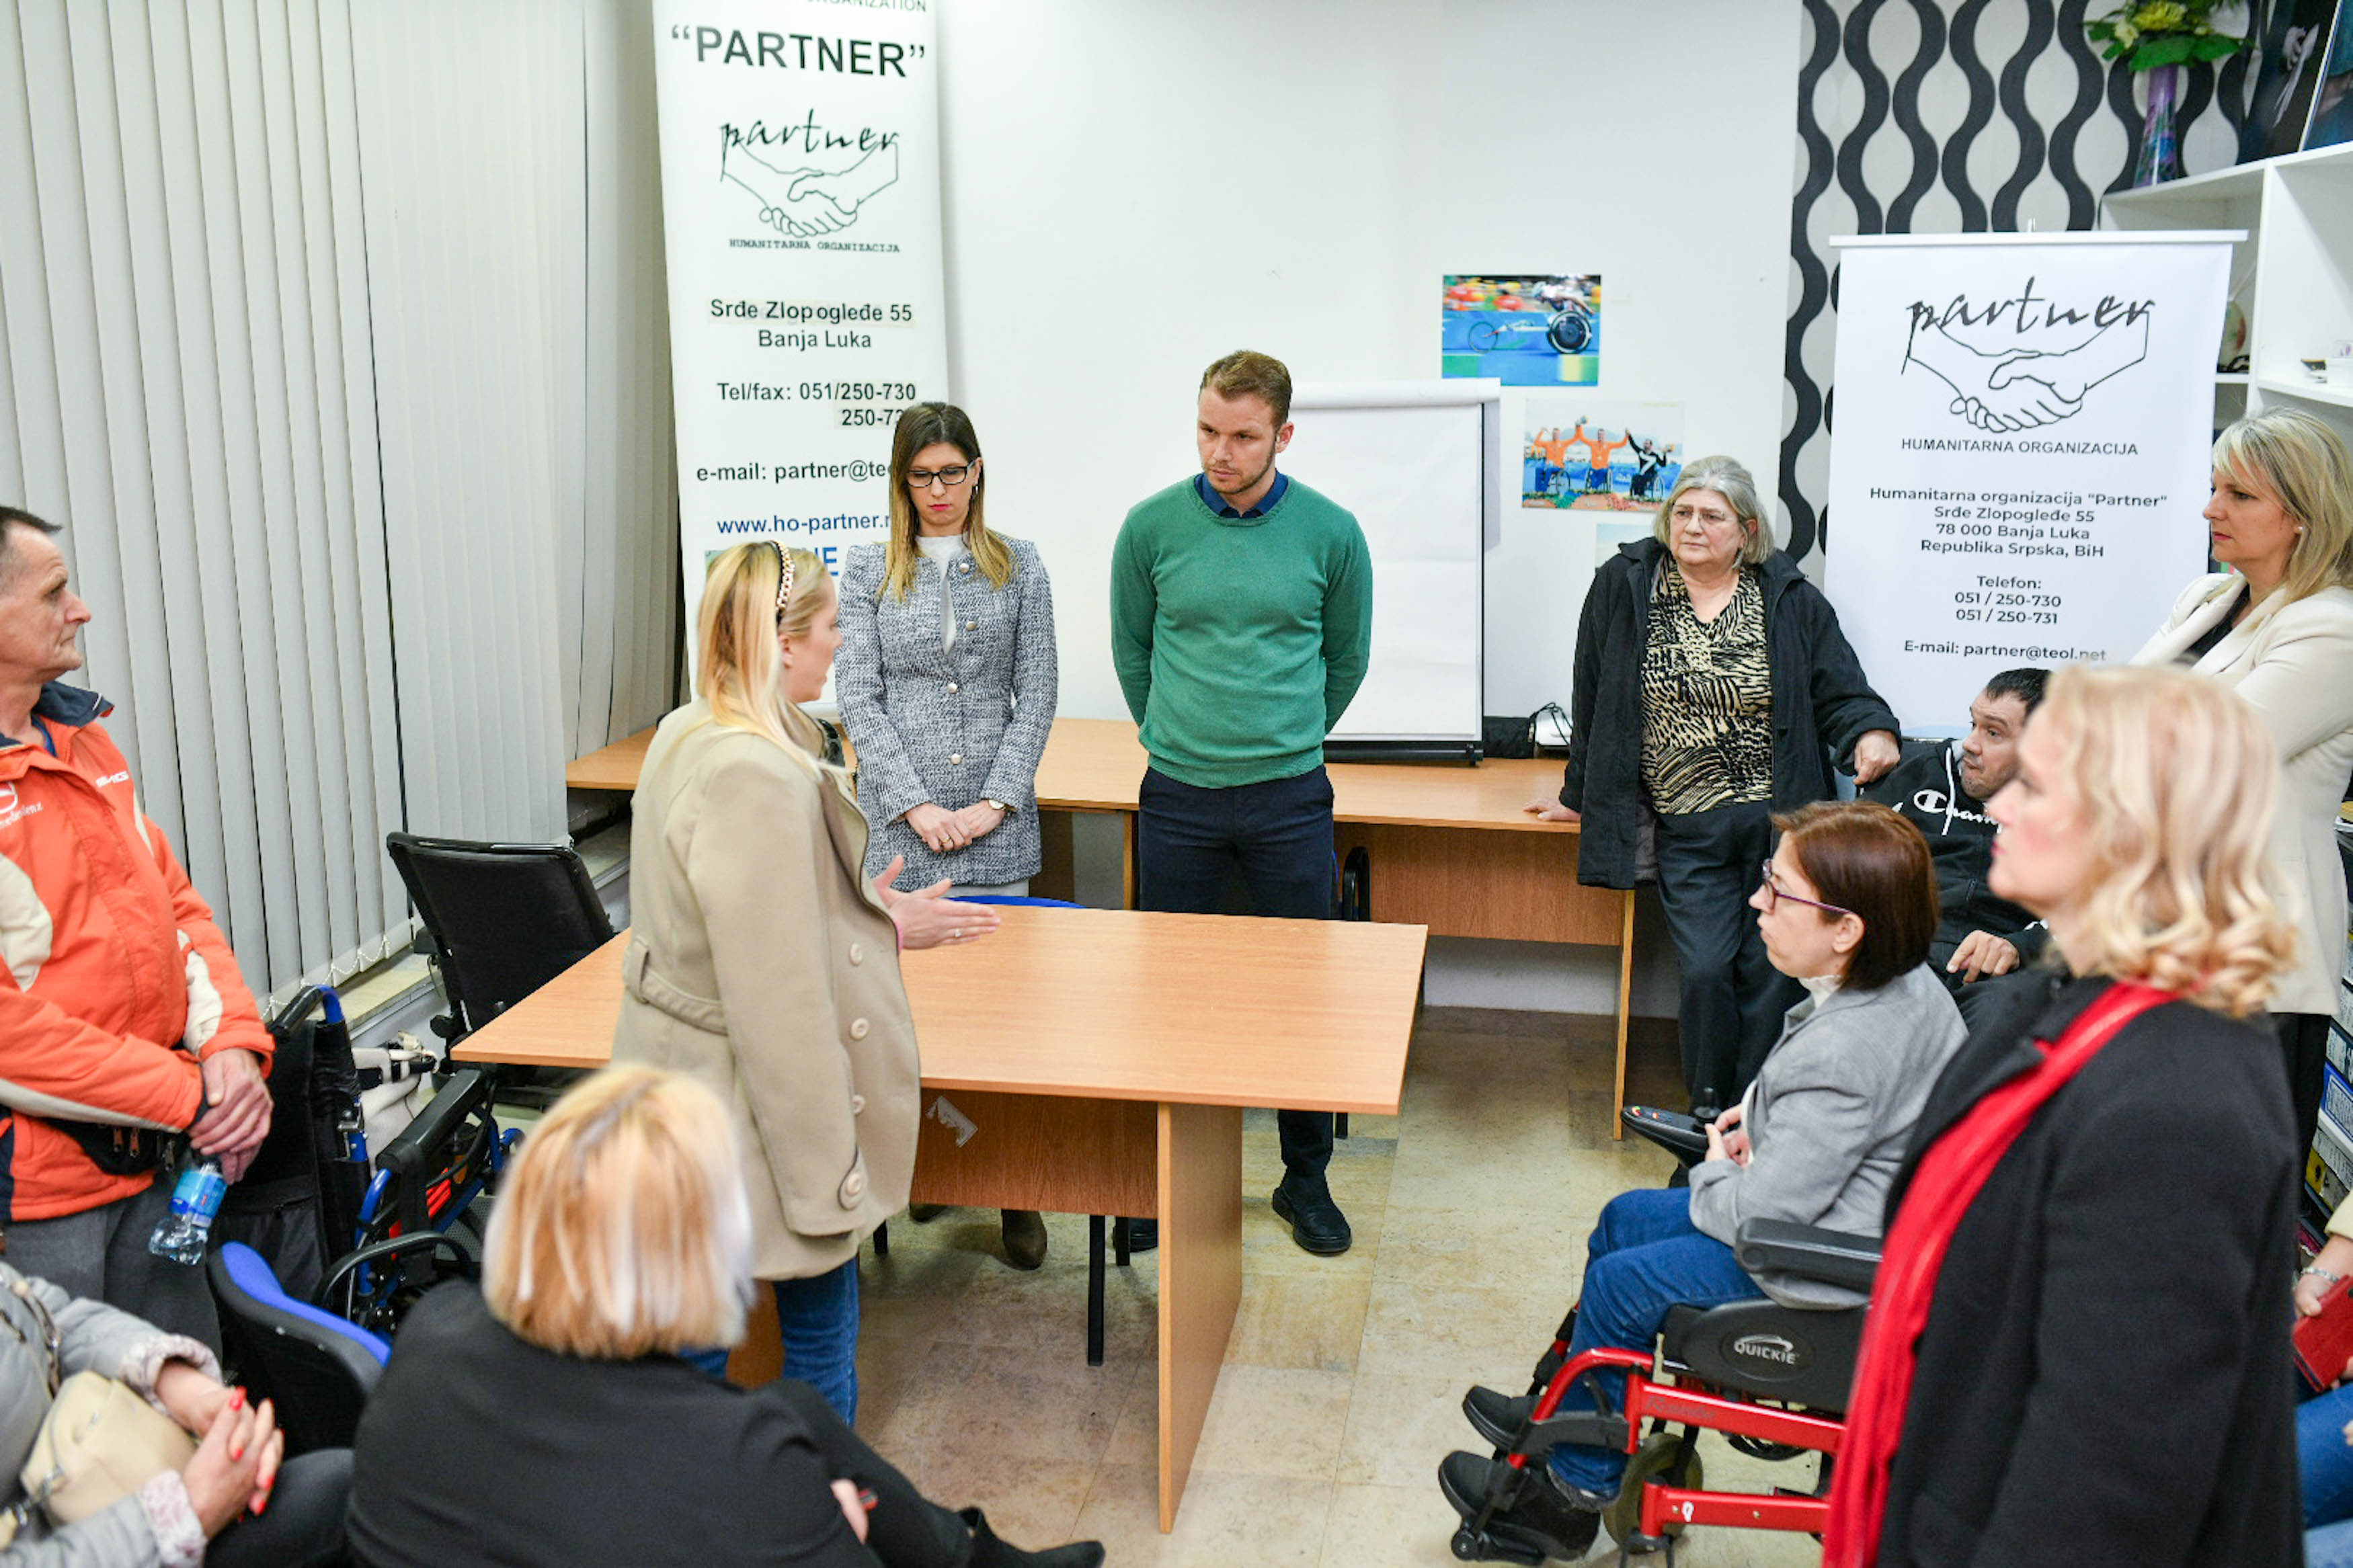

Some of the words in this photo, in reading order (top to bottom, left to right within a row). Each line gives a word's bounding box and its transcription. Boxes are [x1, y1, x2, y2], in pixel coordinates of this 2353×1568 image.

[719, 108, 900, 182] partner
[729, 239, 811, 249] HUMANITARNA
[817, 241, 900, 253] ORGANIZACIJA
[711, 299, 758, 319] Srđe
[890, 304, 912, 321] 55
[1901, 276, 2156, 375] partner
[759, 329, 817, 352] Banja
[826, 331, 871, 347] Luka
[717, 383, 791, 400] Tel/fax:
[800, 382, 916, 400] 051/250-730
[1902, 439, 2013, 452] HUMANITARNA
[2019, 441, 2138, 455] ORGANIZACIJA
[697, 462, 766, 481] e-mail:
[1870, 488, 1975, 501] Humanitarna
[1981, 491, 2082, 506] organizacija
[2088, 494, 2167, 507] "Partner"
[1935, 506, 1971, 518] Srđe
[1977, 507, 2071, 522] Zlopogleđe
[2076, 511, 2094, 522] 55
[1936, 524, 1955, 534] 78
[1960, 524, 1991, 536] 000
[1998, 526, 2044, 540] Banja
[2050, 527, 2089, 539] Luka
[1921, 540, 2003, 554] Republika
[2009, 543, 2069, 558] Srpska,
[2075, 544, 2103, 556] BiH
[1977, 576, 2041, 589] Telefon:
[1955, 592, 1980, 604] 051
[1996, 593, 2061, 607] 250-730
[1956, 610, 1981, 620] 051
[1997, 611, 2057, 624] 250-731
[1905, 641, 1959, 653] E-mail:
[1964, 645, 2105, 660] partner@teol.net
[1734, 1342, 1797, 1365] QUICKIE
